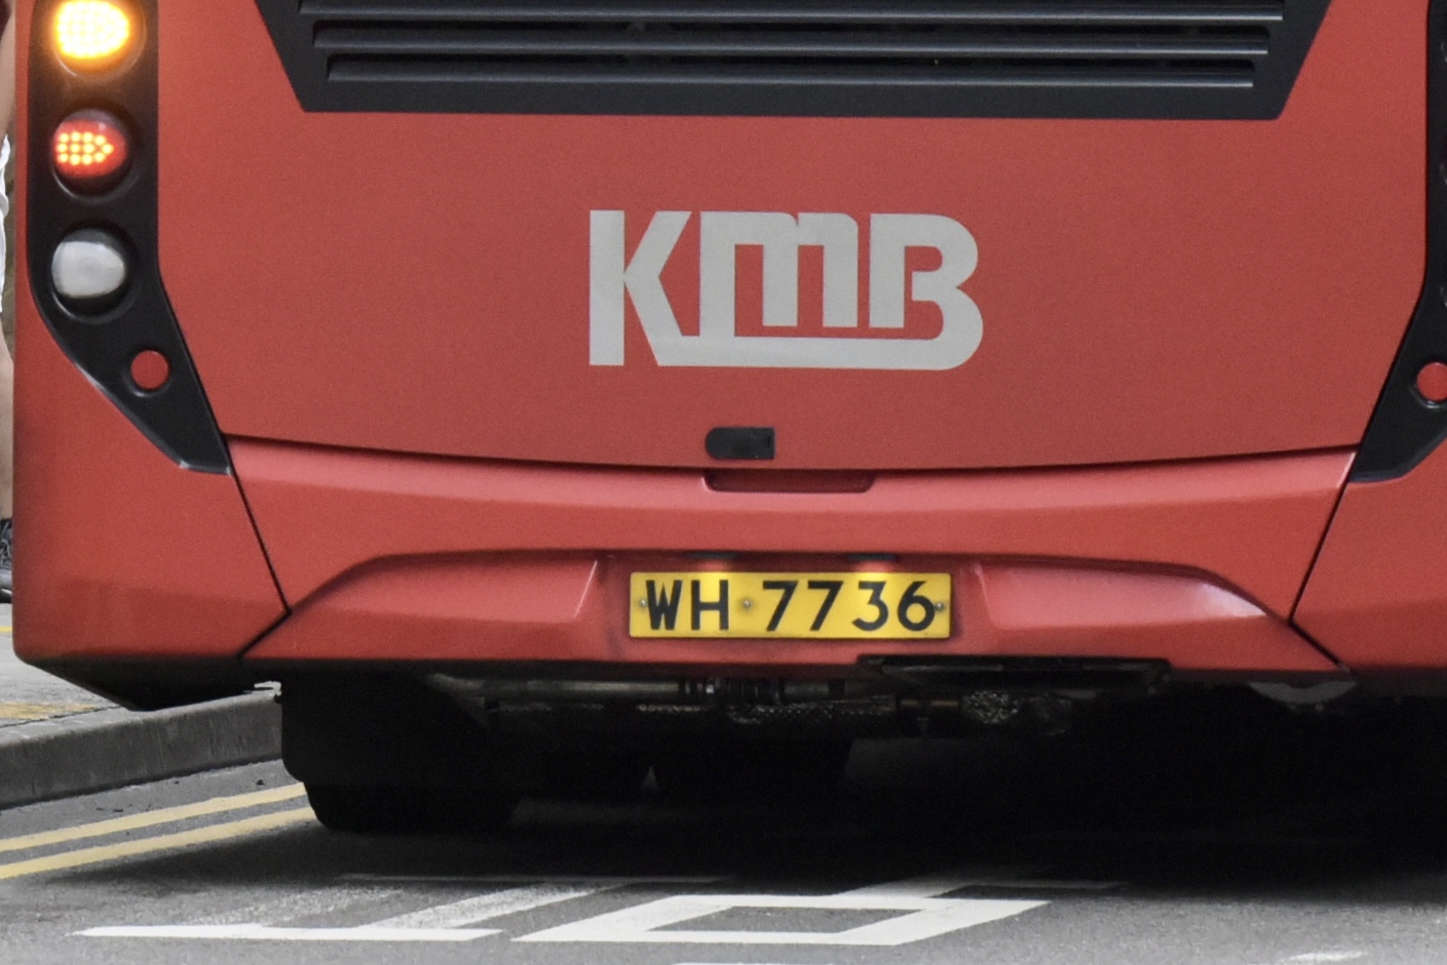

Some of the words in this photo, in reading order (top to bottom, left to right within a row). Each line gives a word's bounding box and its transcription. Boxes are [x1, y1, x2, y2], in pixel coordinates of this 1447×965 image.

[589, 209, 984, 371] KMB
[646, 579, 729, 632] WH
[762, 580, 936, 632] 7736
